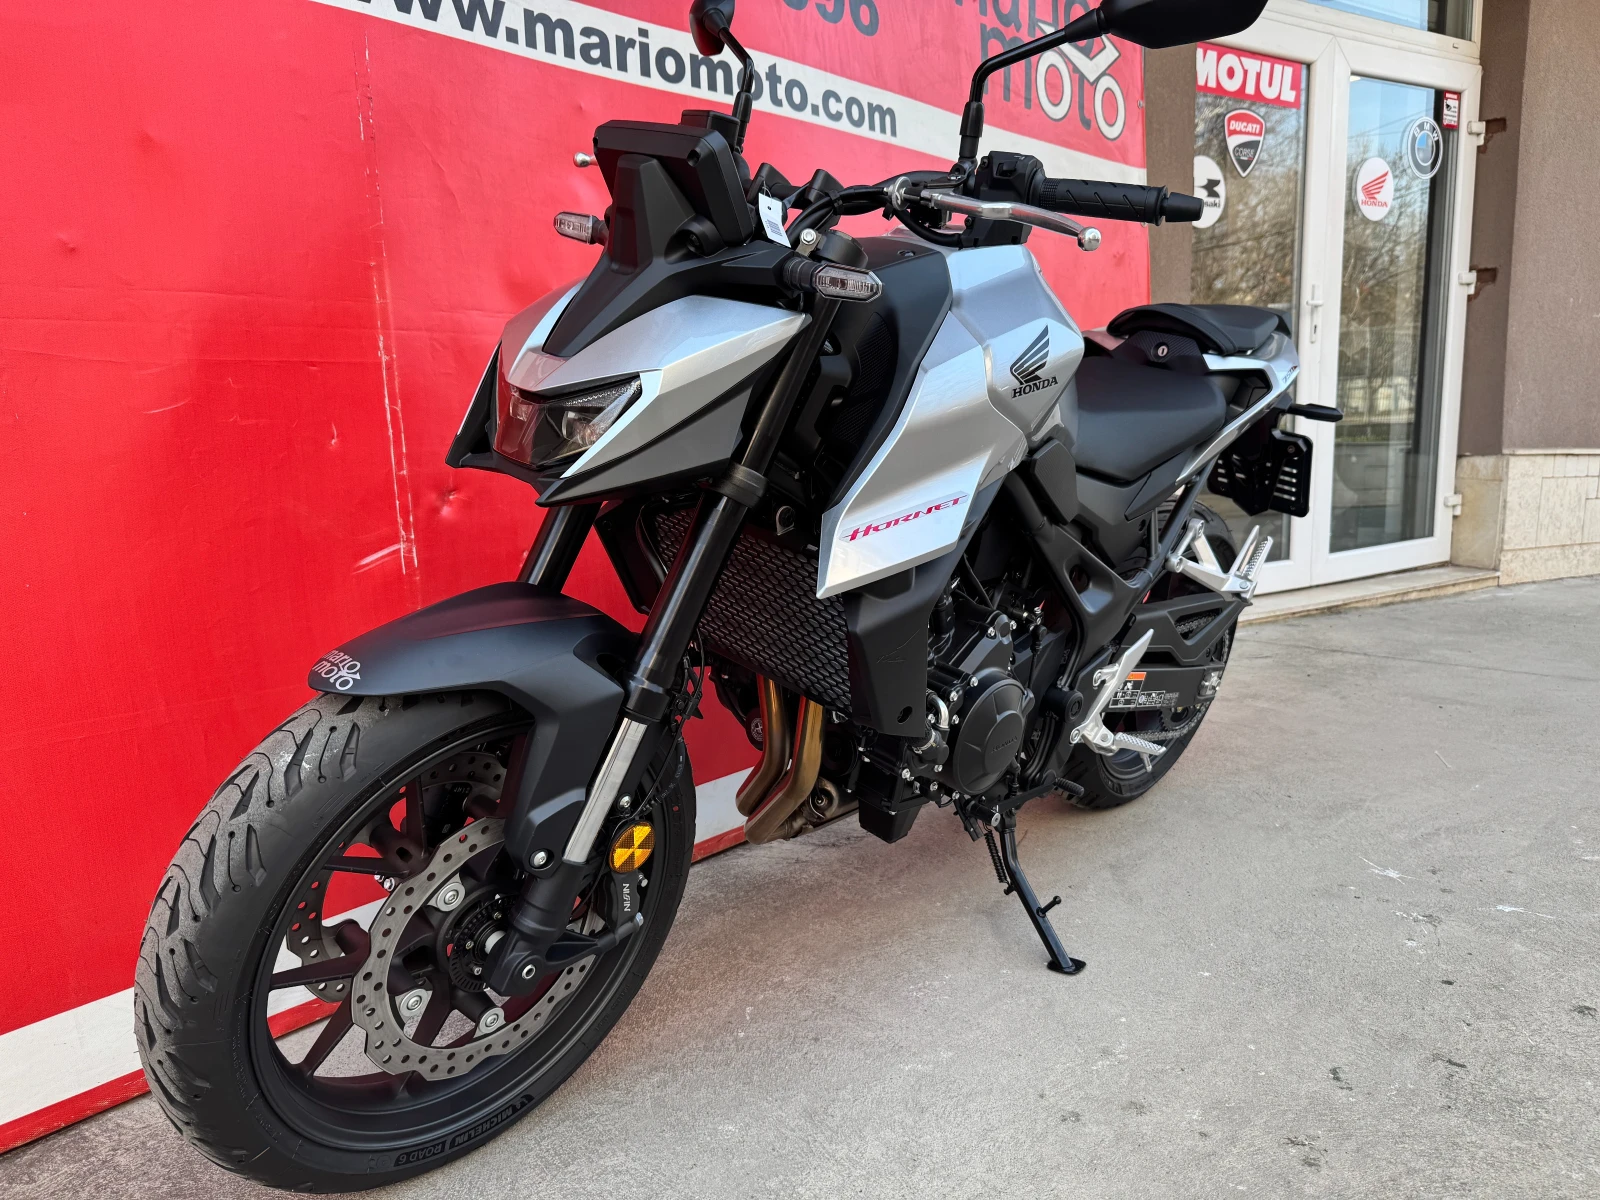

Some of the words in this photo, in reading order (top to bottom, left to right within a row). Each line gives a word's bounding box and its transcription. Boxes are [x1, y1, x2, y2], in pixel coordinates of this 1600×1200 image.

[356, 0, 898, 138] w.mariomoto.com
[1196, 47, 1297, 103] MOTUL
[980, 23, 1127, 142] moto
[1229, 120, 1260, 134] DUCATI
[1413, 121, 1440, 142] BMW
[1234, 146, 1255, 158] CORSE
[1204, 200, 1221, 209] saki
[1361, 200, 1388, 208] HONDA
[1011, 376, 1058, 399] HONDA
[842, 495, 968, 542] HORNET
[322, 649, 361, 674] mario
[311, 660, 354, 691] moto
[454, 1104, 514, 1147] MICHELIN
[397, 1154, 407, 1165] 6
[409, 1143, 442, 1162] ROAD
